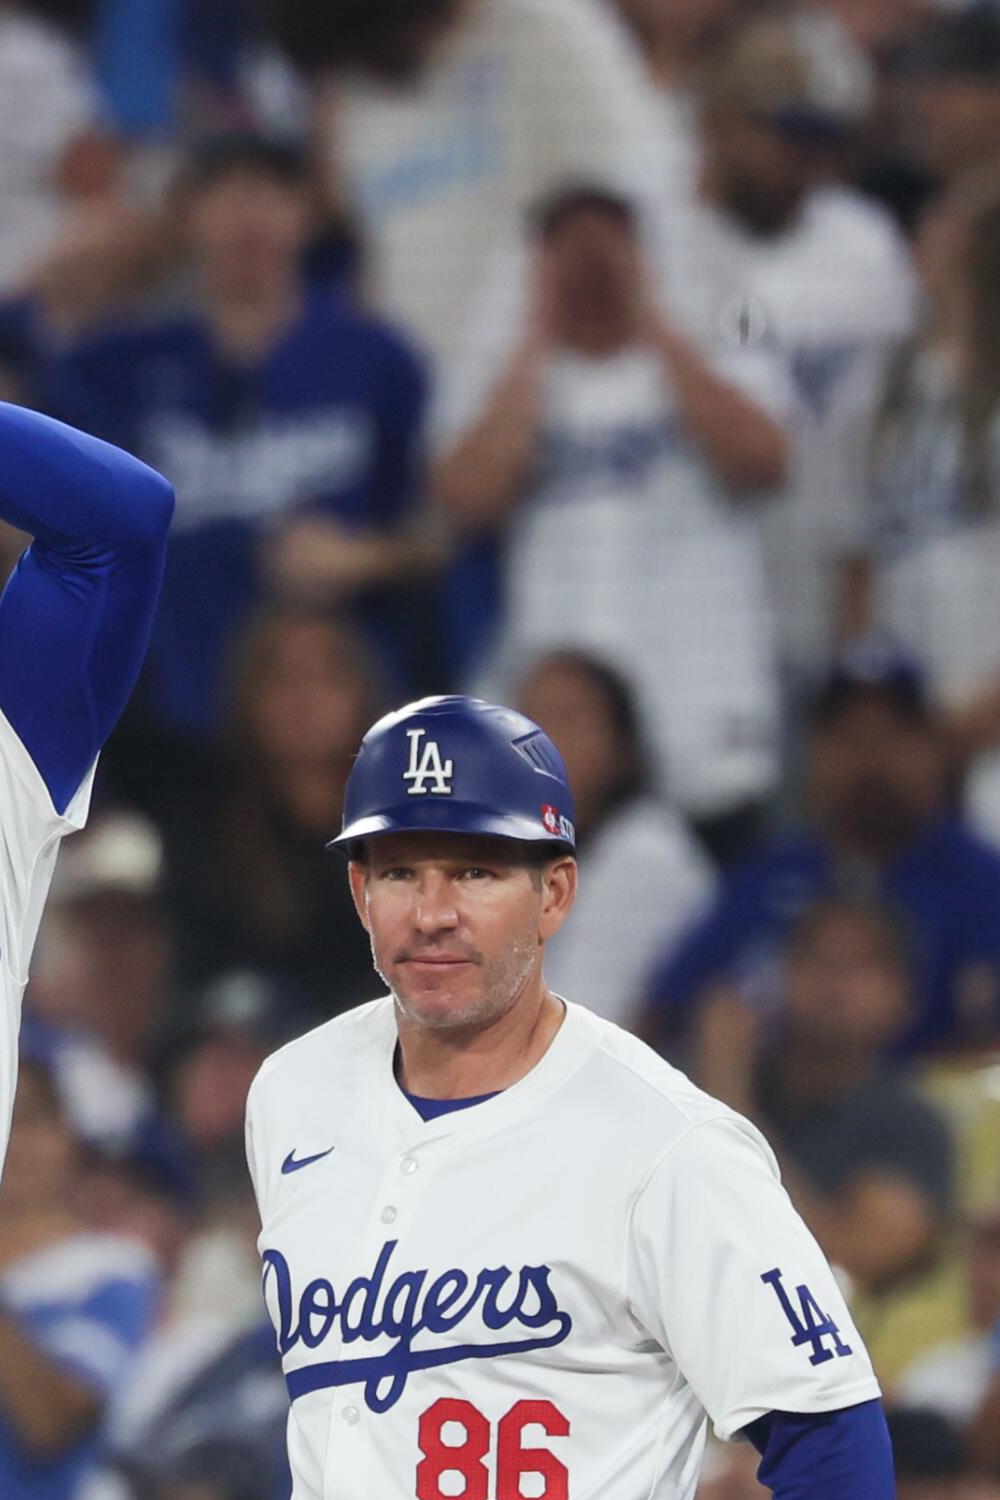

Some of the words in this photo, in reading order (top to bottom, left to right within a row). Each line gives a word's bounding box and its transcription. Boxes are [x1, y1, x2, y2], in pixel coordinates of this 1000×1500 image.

[403, 728, 453, 794] LA
[263, 1239, 573, 1414] Dodgers
[760, 1267, 853, 1366] LA
